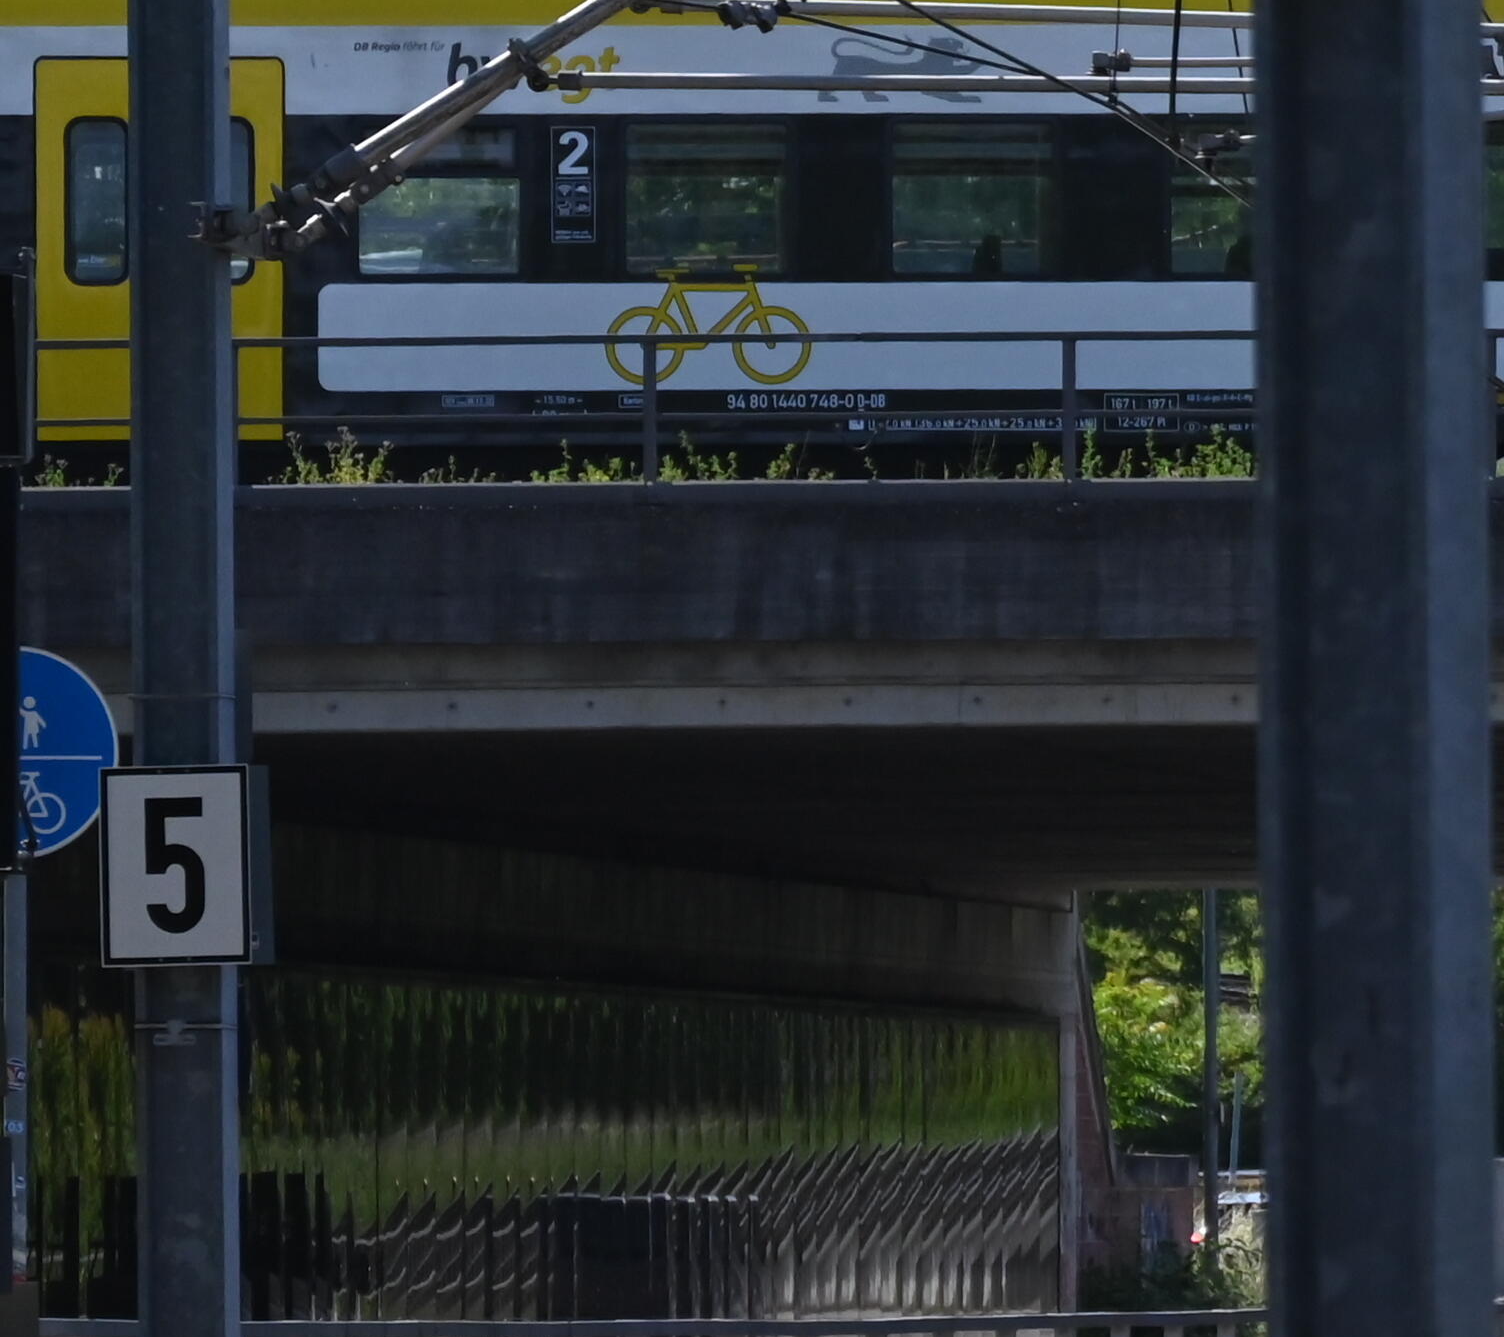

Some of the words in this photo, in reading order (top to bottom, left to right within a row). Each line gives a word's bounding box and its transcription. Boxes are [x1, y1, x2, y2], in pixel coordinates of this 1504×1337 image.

[353, 42, 369, 52] DB
[371, 42, 400, 53] Regio
[558, 130, 589, 175] 2
[727, 394, 746, 409] 94
[749, 394, 768, 408] 80
[771, 393, 806, 408] 1440
[810, 393, 854, 408] 748-0
[857, 393, 886, 411] D-DB
[144, 796, 206, 934] 5
